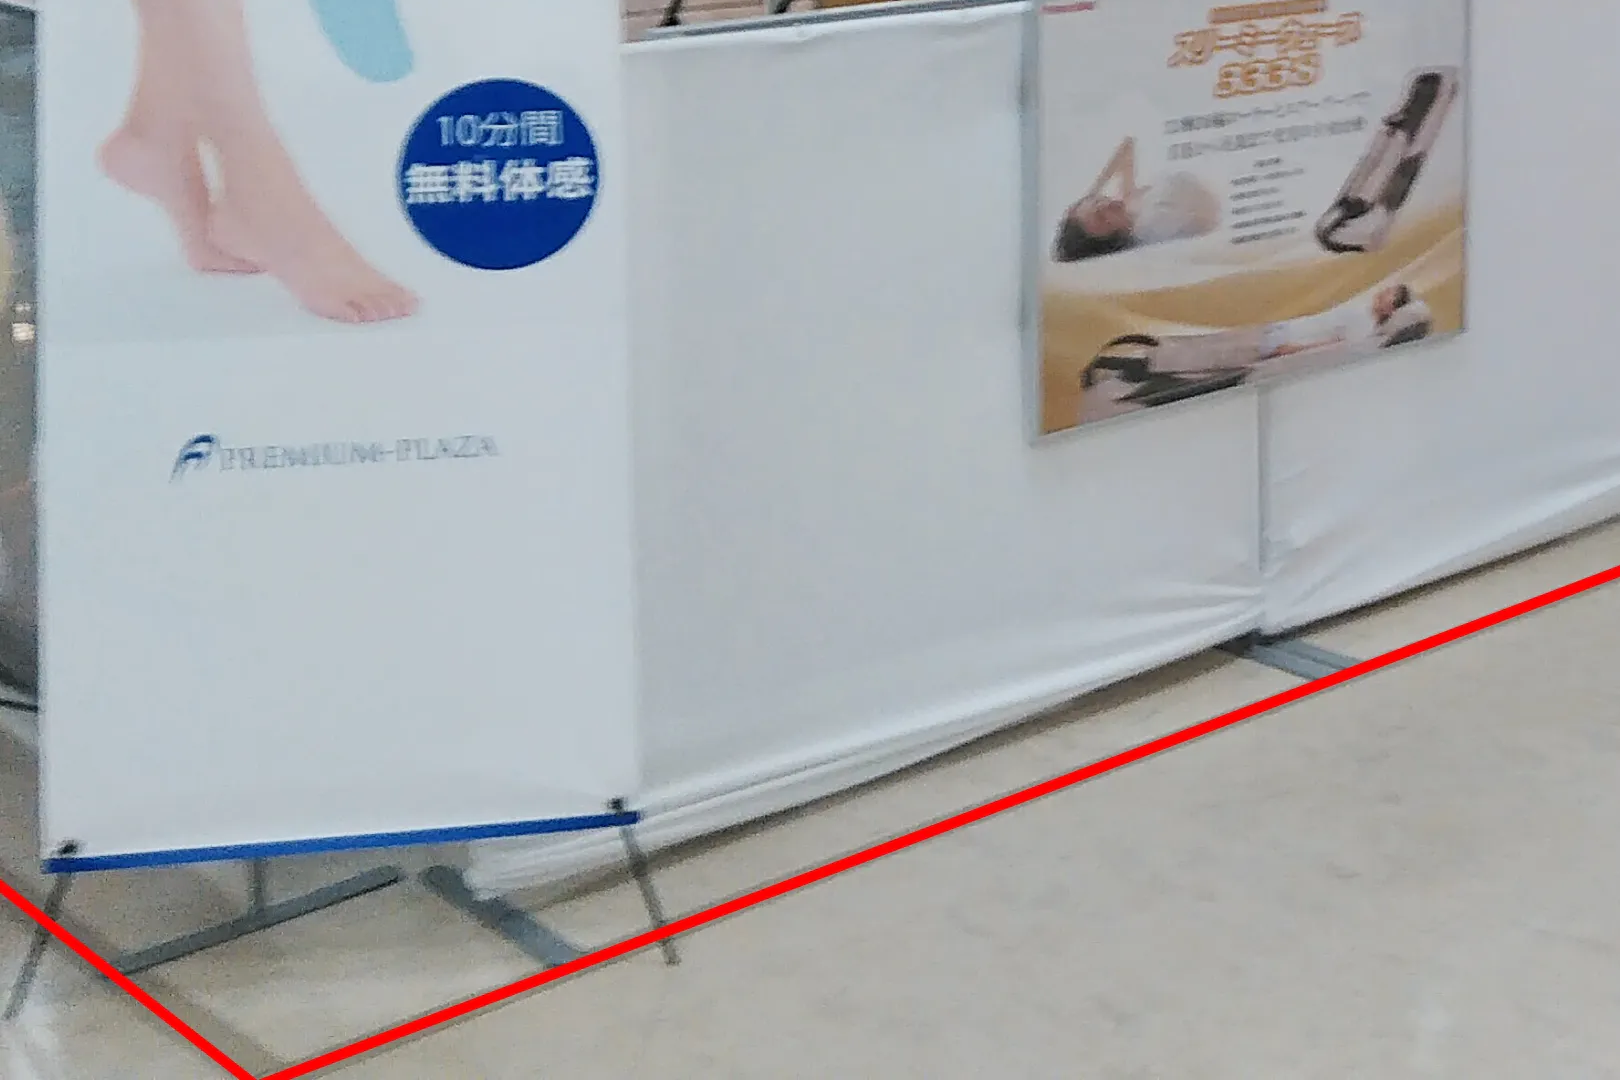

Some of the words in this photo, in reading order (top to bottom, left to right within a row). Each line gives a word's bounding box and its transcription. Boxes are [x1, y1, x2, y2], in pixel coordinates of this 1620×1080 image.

[436, 109, 565, 148] 10分間
[404, 156, 595, 205] 無料体感
